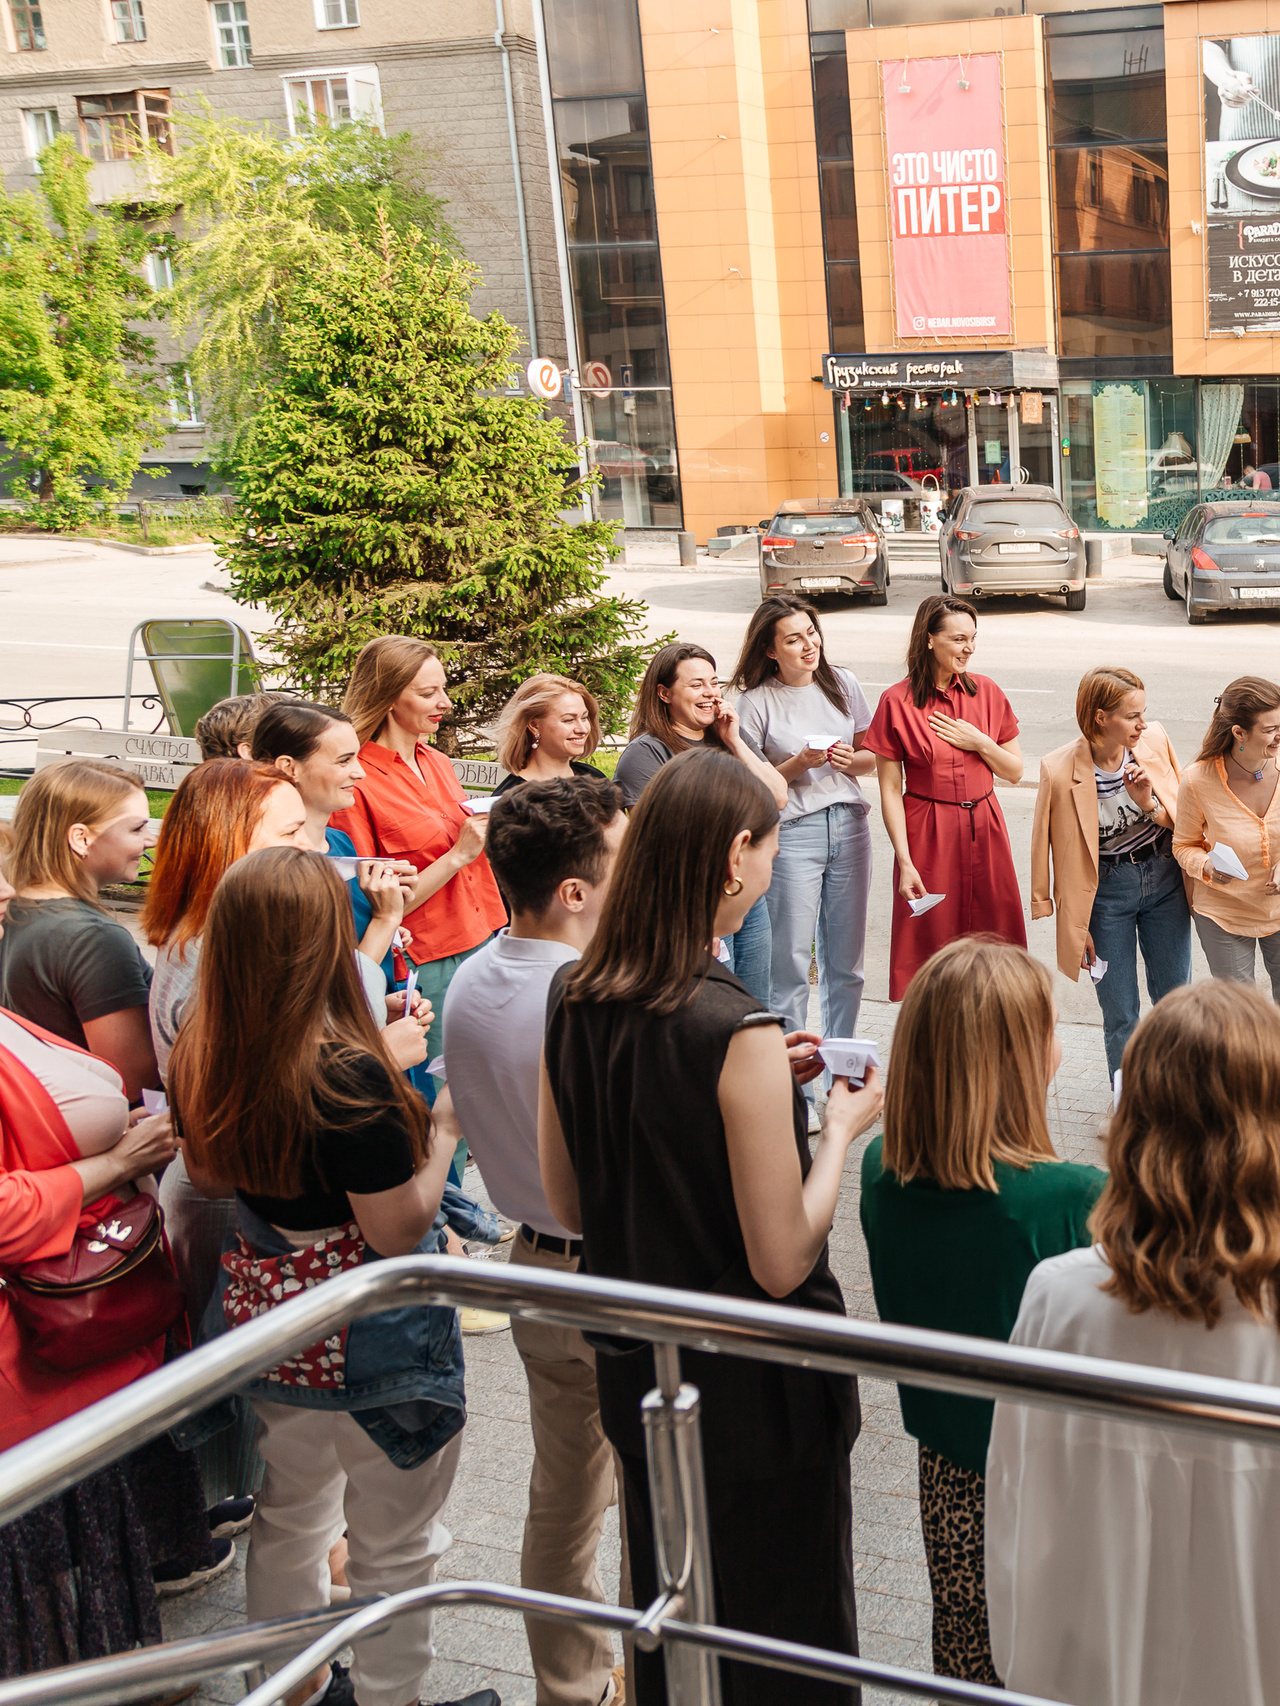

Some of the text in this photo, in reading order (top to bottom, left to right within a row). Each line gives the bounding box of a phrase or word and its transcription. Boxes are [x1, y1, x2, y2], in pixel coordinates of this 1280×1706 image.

[892, 148, 998, 185] ЭТО ЧИСТО
[897, 184, 1001, 235] ПИТЕР
[1251, 289, 1265, 297] 913
[1266, 288, 1280, 297] 770
[125, 738, 189, 758] СЧАСТЬЯ
